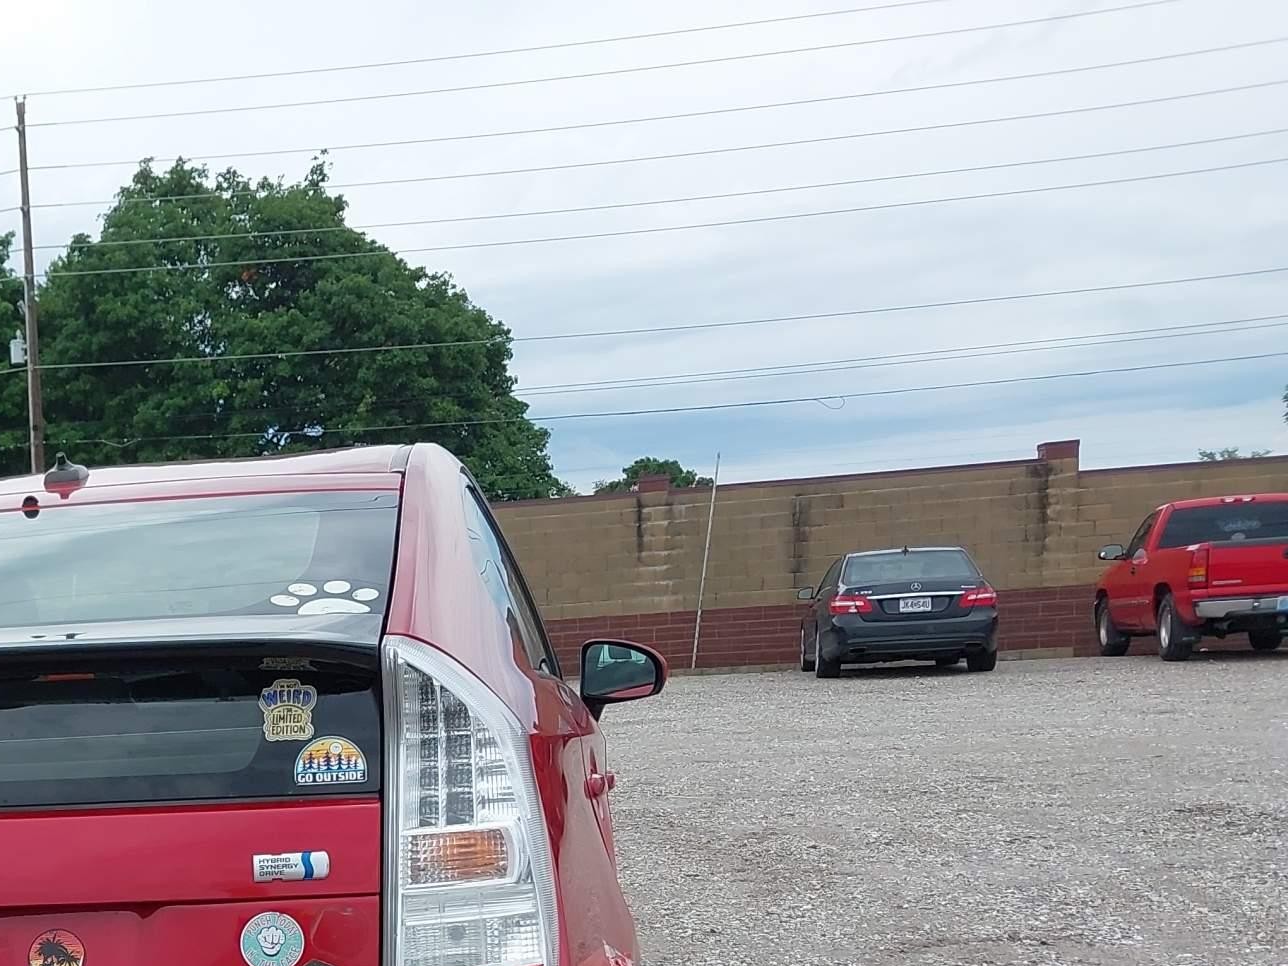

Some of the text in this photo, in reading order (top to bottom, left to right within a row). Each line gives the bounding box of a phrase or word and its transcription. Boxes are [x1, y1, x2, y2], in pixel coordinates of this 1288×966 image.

[262, 689, 312, 708] WEIRD
[272, 713, 303, 725] LIMITED
[272, 725, 306, 735] EDITION
[297, 771, 364, 783] GO OUTSIDE
[247, 916, 297, 937] PUNCH TODAY
[246, 947, 255, 959] IN
[280, 945, 300, 966] FACE
